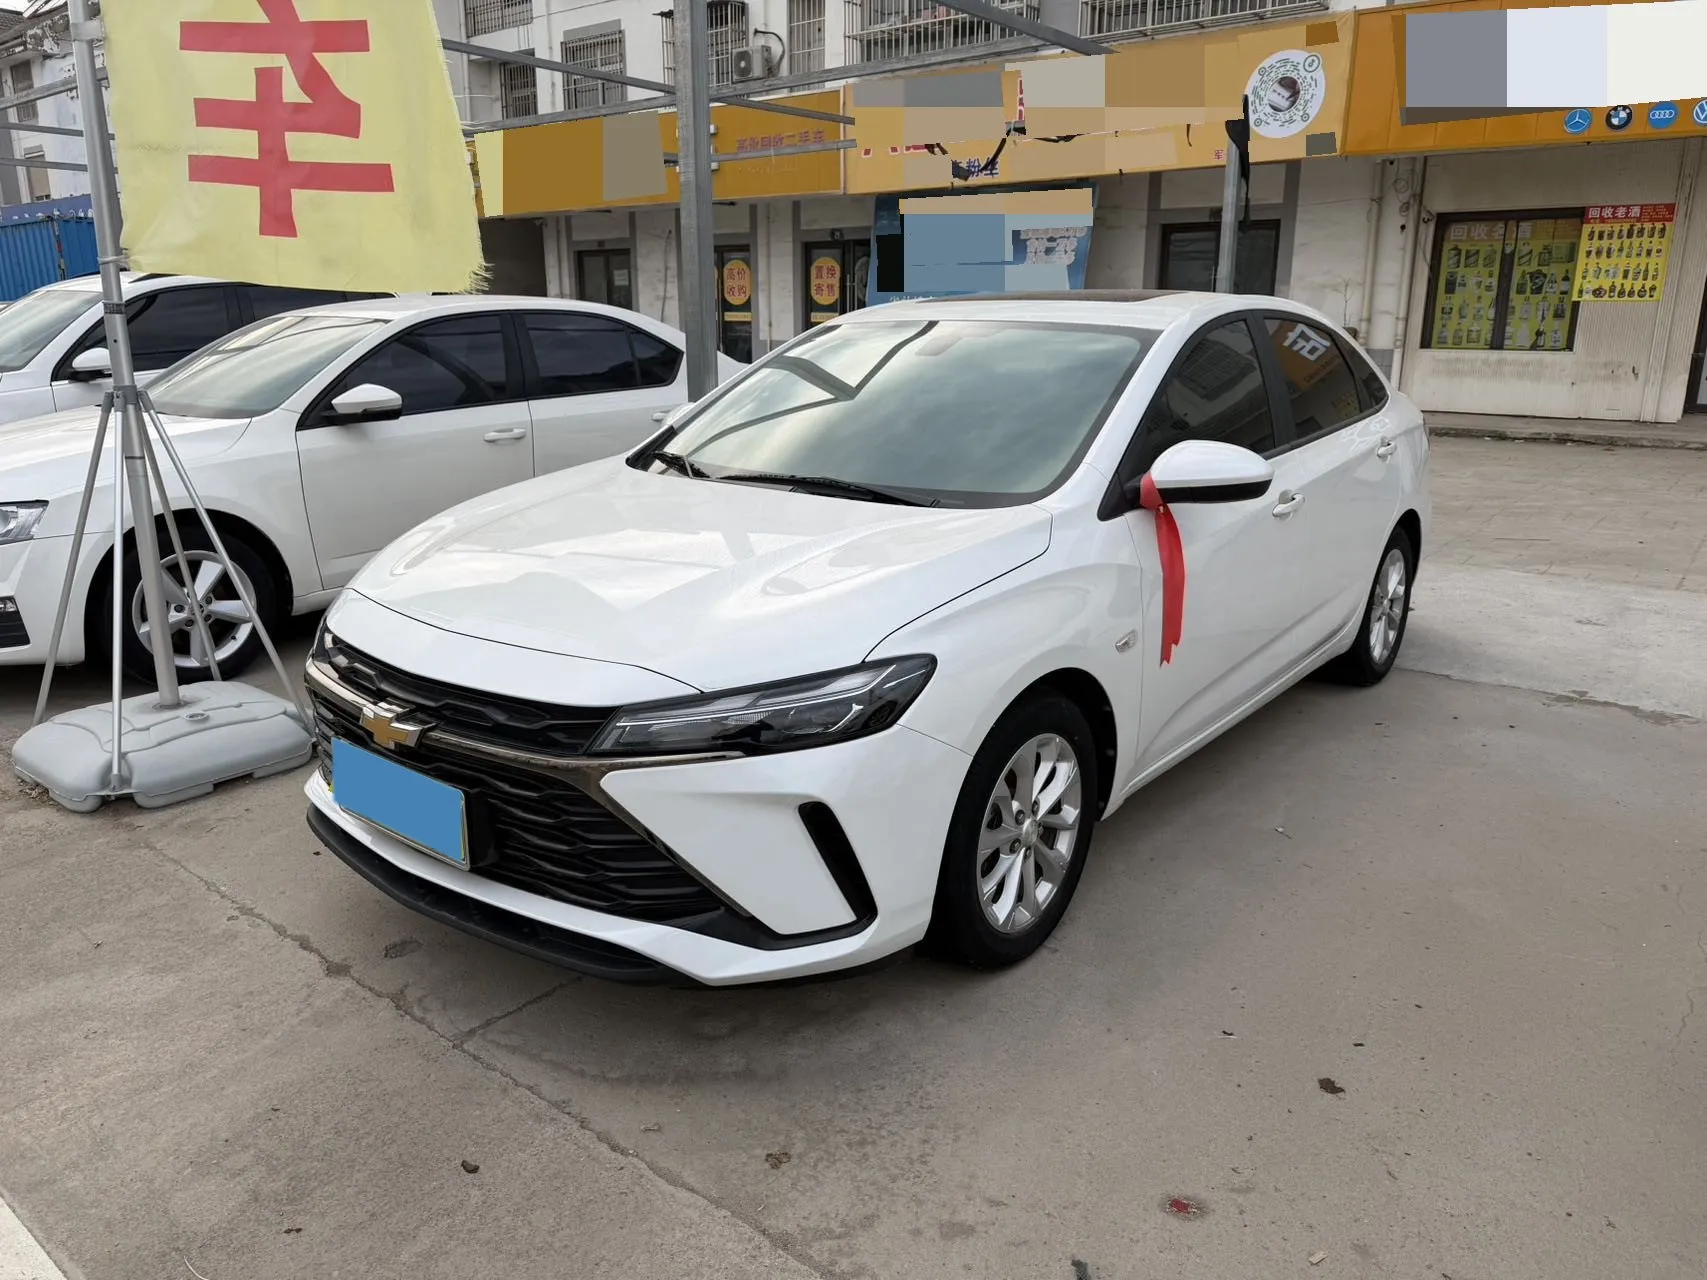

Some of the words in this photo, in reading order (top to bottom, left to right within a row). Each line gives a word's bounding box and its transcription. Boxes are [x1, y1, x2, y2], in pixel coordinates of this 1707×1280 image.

[1588, 205, 1641, 219] 回收老酒
[727, 267, 746, 281] 高价
[814, 264, 837, 280] 置换
[727, 283, 747, 298] 收购
[814, 282, 836, 297] 寄售
